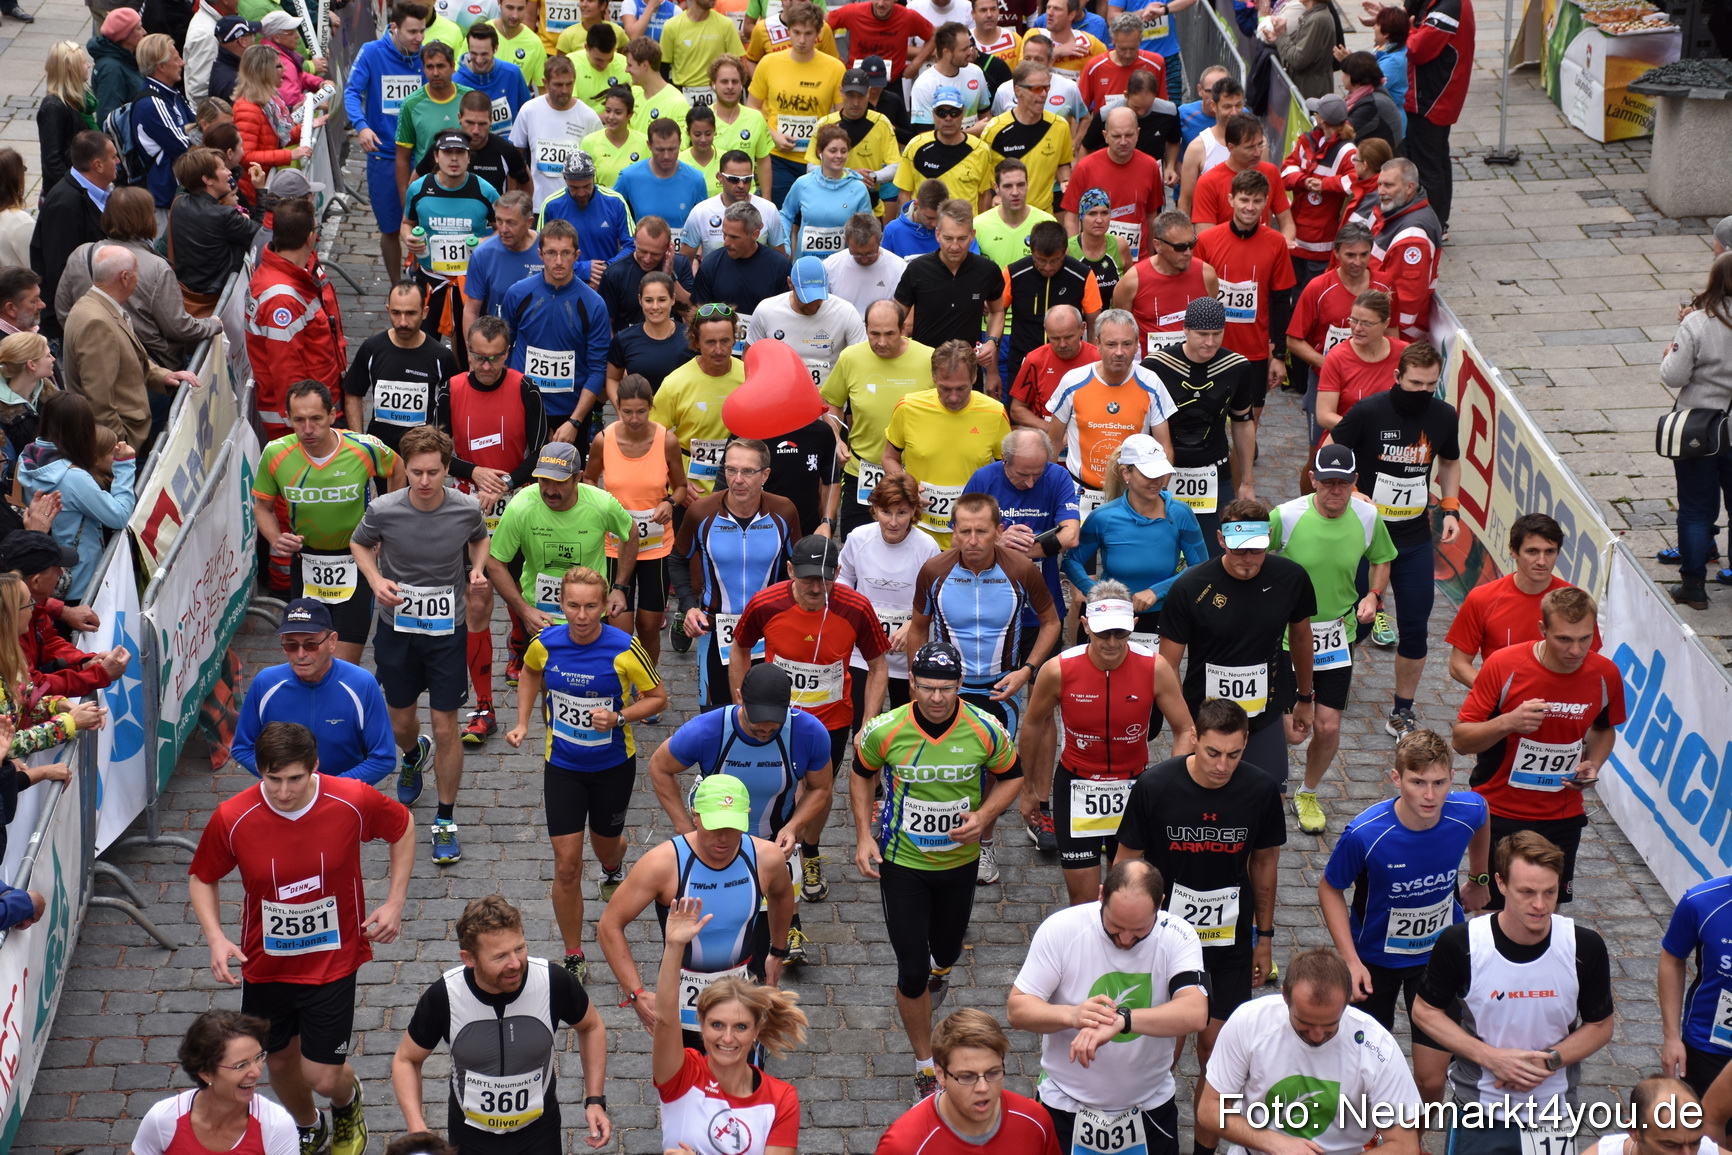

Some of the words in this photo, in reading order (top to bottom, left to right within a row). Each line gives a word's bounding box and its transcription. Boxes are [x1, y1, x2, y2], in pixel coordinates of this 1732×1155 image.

[548, 7, 579, 20] 2731
[386, 84, 419, 98] 2108
[780, 123, 814, 139] 2732
[1003, 143, 1026, 152] Markus
[540, 148, 567, 163] 230
[924, 161, 940, 170] Peter
[428, 216, 473, 228] HUBER
[807, 236, 842, 250] 2659
[439, 245, 466, 260] 181
[446, 263, 461, 271] Sven
[1217, 291, 1254, 308] 2138
[530, 358, 571, 378] 2515
[541, 379, 557, 388] Maik
[380, 391, 424, 411] 2026
[390, 412, 412, 422] Eyuep
[1087, 421, 1136, 431] SportScheck
[1383, 431, 1398, 439] 2014
[776, 447, 799, 455] skinfit
[1382, 443, 1419, 457] TOUGH
[1380, 453, 1418, 464] MUDDER
[861, 463, 878, 471] PARTL
[1175, 479, 1208, 496] 209
[1377, 477, 1396, 487] PARTL
[284, 483, 360, 503] BOCK
[1391, 488, 1413, 506] 71
[998, 507, 1020, 518] hella
[1383, 507, 1413, 517] Thomas
[303, 557, 319, 566] PARTL
[312, 566, 347, 586] 382
[538, 577, 556, 585] PARTL
[317, 588, 342, 599] Reiner
[418, 590, 445, 598] Neumarkt
[402, 597, 451, 618] 2109
[717, 617, 737, 625] PARTL
[877, 613, 905, 622] Neumarkt
[416, 619, 433, 630] Uwe
[774, 658, 791, 670] PARTL
[792, 666, 822, 675] Neumarkt
[1207, 668, 1228, 678] PARTL
[1229, 671, 1259, 679] Neumarkt
[566, 677, 591, 686] LANGE
[1218, 679, 1258, 698] 504
[553, 693, 572, 706] PARTL
[573, 729, 589, 740] Eva
[1520, 742, 1544, 752] PARTL
[1545, 746, 1577, 755] Neumarkt
[1520, 753, 1579, 773] 2197
[897, 764, 977, 783] BOCK
[1536, 776, 1554, 786] Tim
[1072, 783, 1095, 792] PARTL
[1095, 785, 1127, 793] Neumarkt
[904, 801, 927, 812] PARTL
[927, 805, 960, 813] Neumarkt
[1085, 793, 1125, 815] 503
[909, 812, 964, 834] 2809
[1166, 825, 1250, 843] UNDER
[1168, 841, 1246, 854] ARMOUR
[1390, 869, 1457, 893] SYSCAD
[289, 882, 310, 894] DEHN
[1174, 889, 1197, 903] PARTL
[1197, 894, 1230, 904] Neumarkt
[264, 904, 288, 915] PARTL
[288, 904, 324, 916] Neumarkt
[1182, 903, 1225, 926] 221
[1392, 910, 1419, 918] PARTL
[1419, 900, 1448, 917] Neumarkt
[270, 911, 331, 937] 2581
[1395, 906, 1451, 937] 2057
[275, 935, 329, 950] Carl-Jonas
[1408, 937, 1436, 949] Niklas
[1507, 989, 1559, 1000] KLEBL
[466, 1077, 493, 1090] PARTL
[494, 1079, 533, 1090] Neumarkt
[704, 1084, 721, 1095] erima
[480, 1089, 530, 1114] 360
[487, 1117, 520, 1129] Oliver
[1080, 1108, 1101, 1125] PARTL
[1080, 1119, 1139, 1152] 3031
